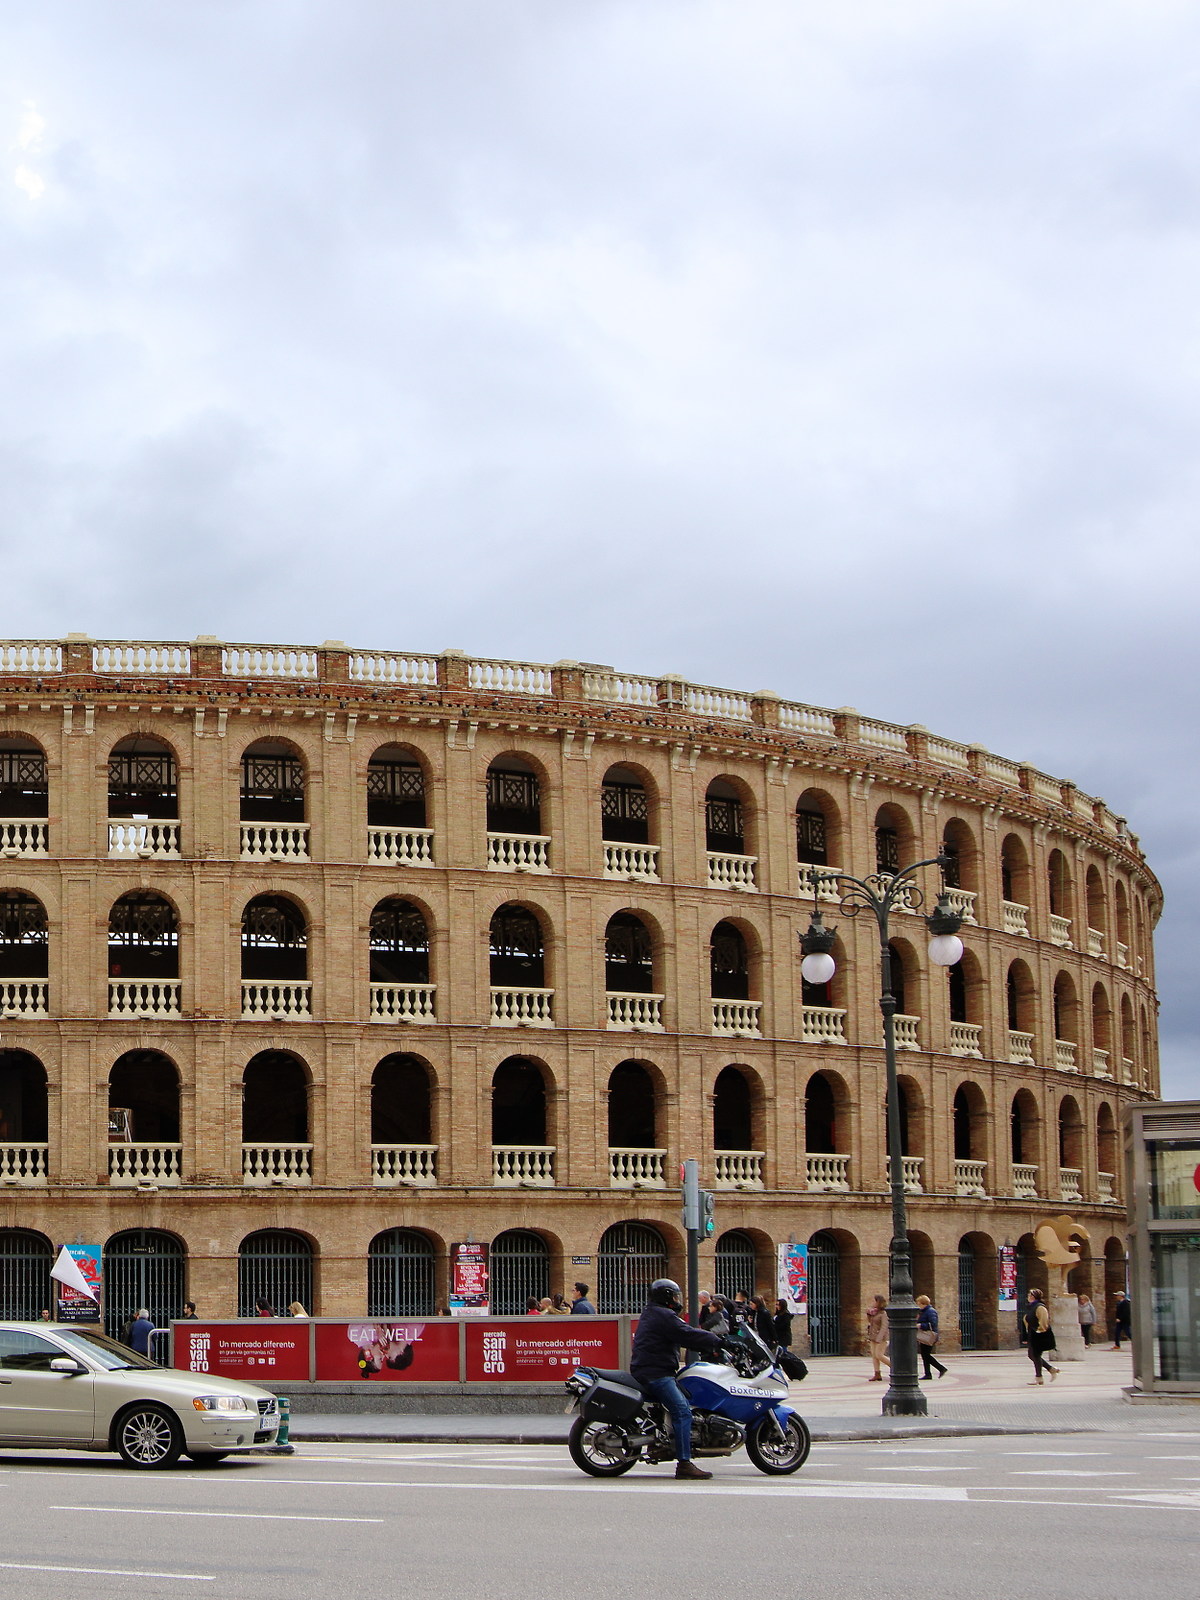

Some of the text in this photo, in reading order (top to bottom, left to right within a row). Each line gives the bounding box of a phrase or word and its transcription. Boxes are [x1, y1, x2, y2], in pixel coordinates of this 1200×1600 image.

[350, 1329, 422, 1342] EAT WELL
[190, 1339, 210, 1350] san
[263, 1340, 295, 1348] diferente
[483, 1338, 506, 1349] san
[529, 1339, 564, 1348] mercado
[566, 1339, 602, 1347] diferente
[190, 1350, 207, 1360] val
[483, 1350, 502, 1361] val
[190, 1361, 208, 1372] ero
[484, 1362, 505, 1373] ero
[730, 1386, 774, 1398] BoxerCup
